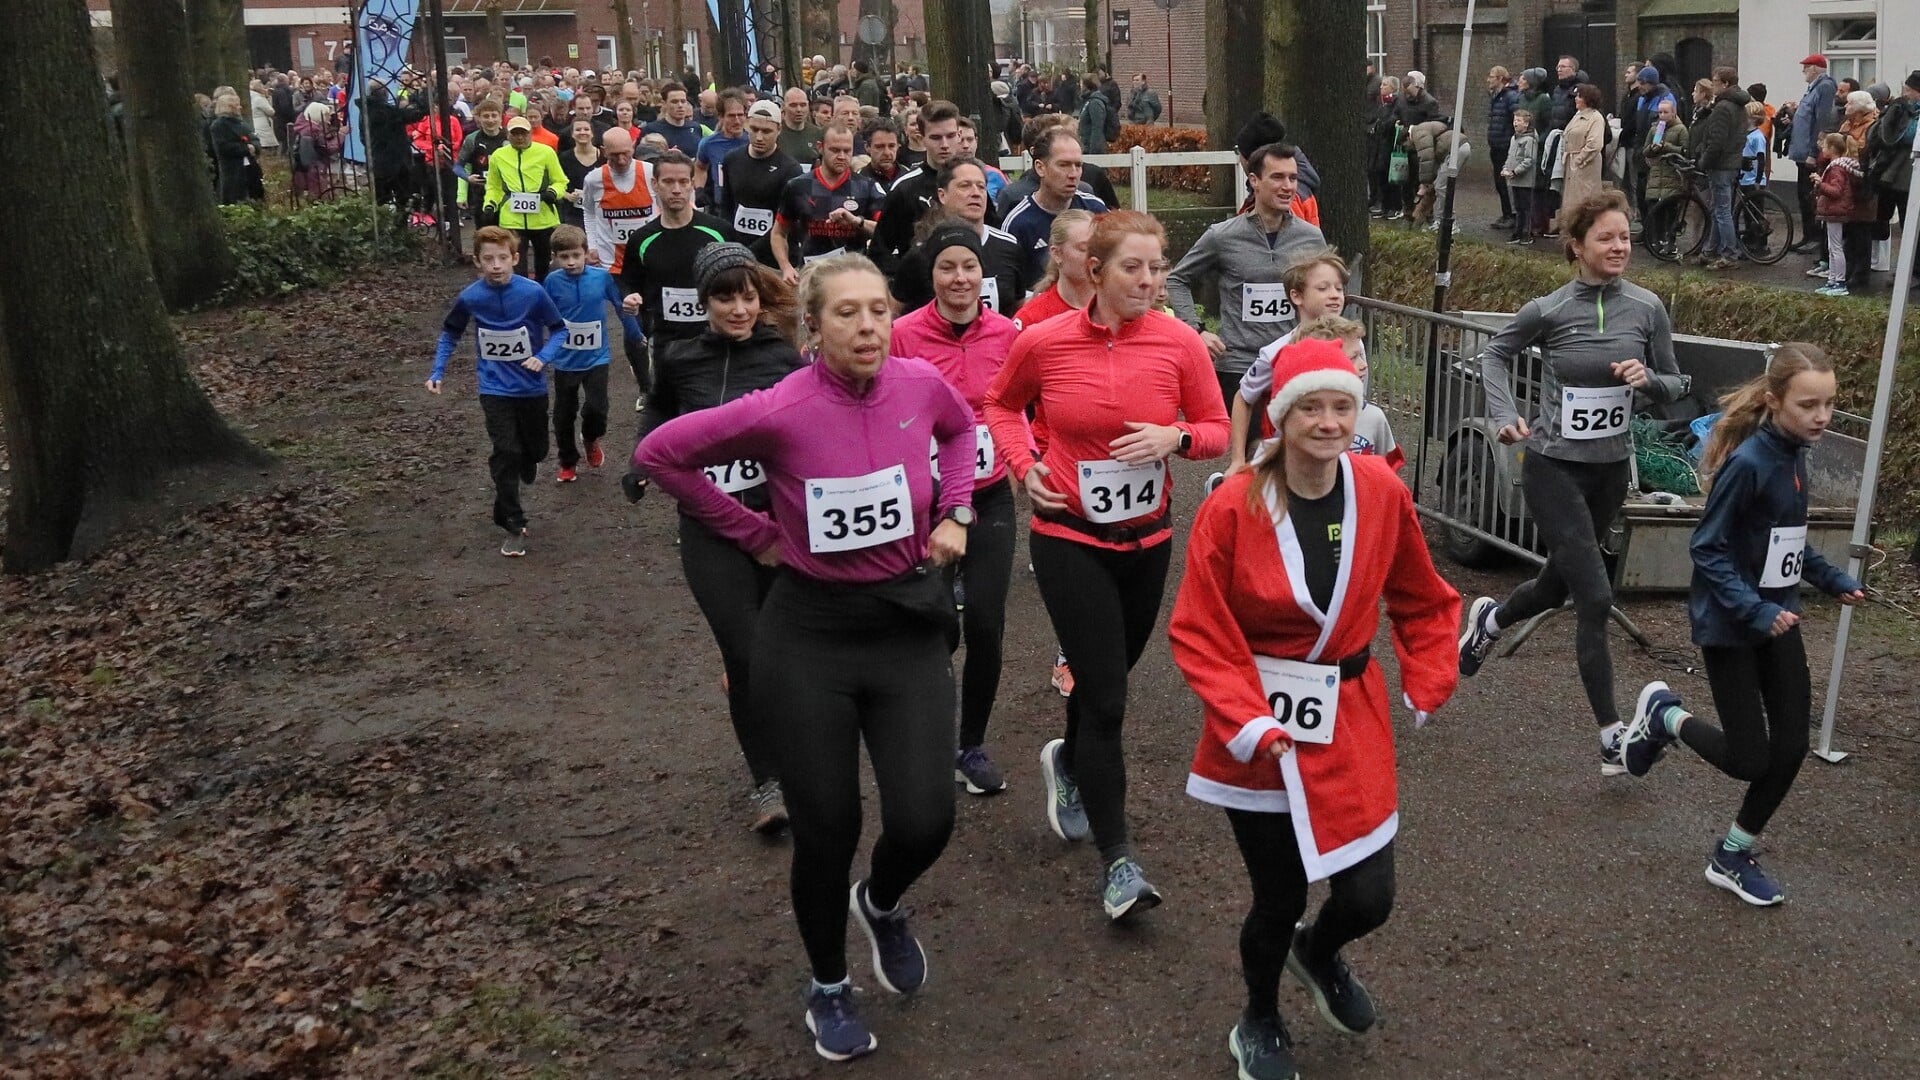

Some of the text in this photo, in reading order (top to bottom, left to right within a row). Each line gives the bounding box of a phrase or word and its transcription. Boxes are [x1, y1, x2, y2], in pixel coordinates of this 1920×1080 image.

[513, 200, 537, 210] 208
[737, 217, 768, 231] 486
[669, 302, 707, 317] 439
[1249, 299, 1291, 316] 545
[485, 341, 526, 357] 224
[1571, 406, 1625, 431] 526
[1090, 479, 1156, 513] 314
[822, 497, 901, 540] 355
[1268, 691, 1323, 730] 06
